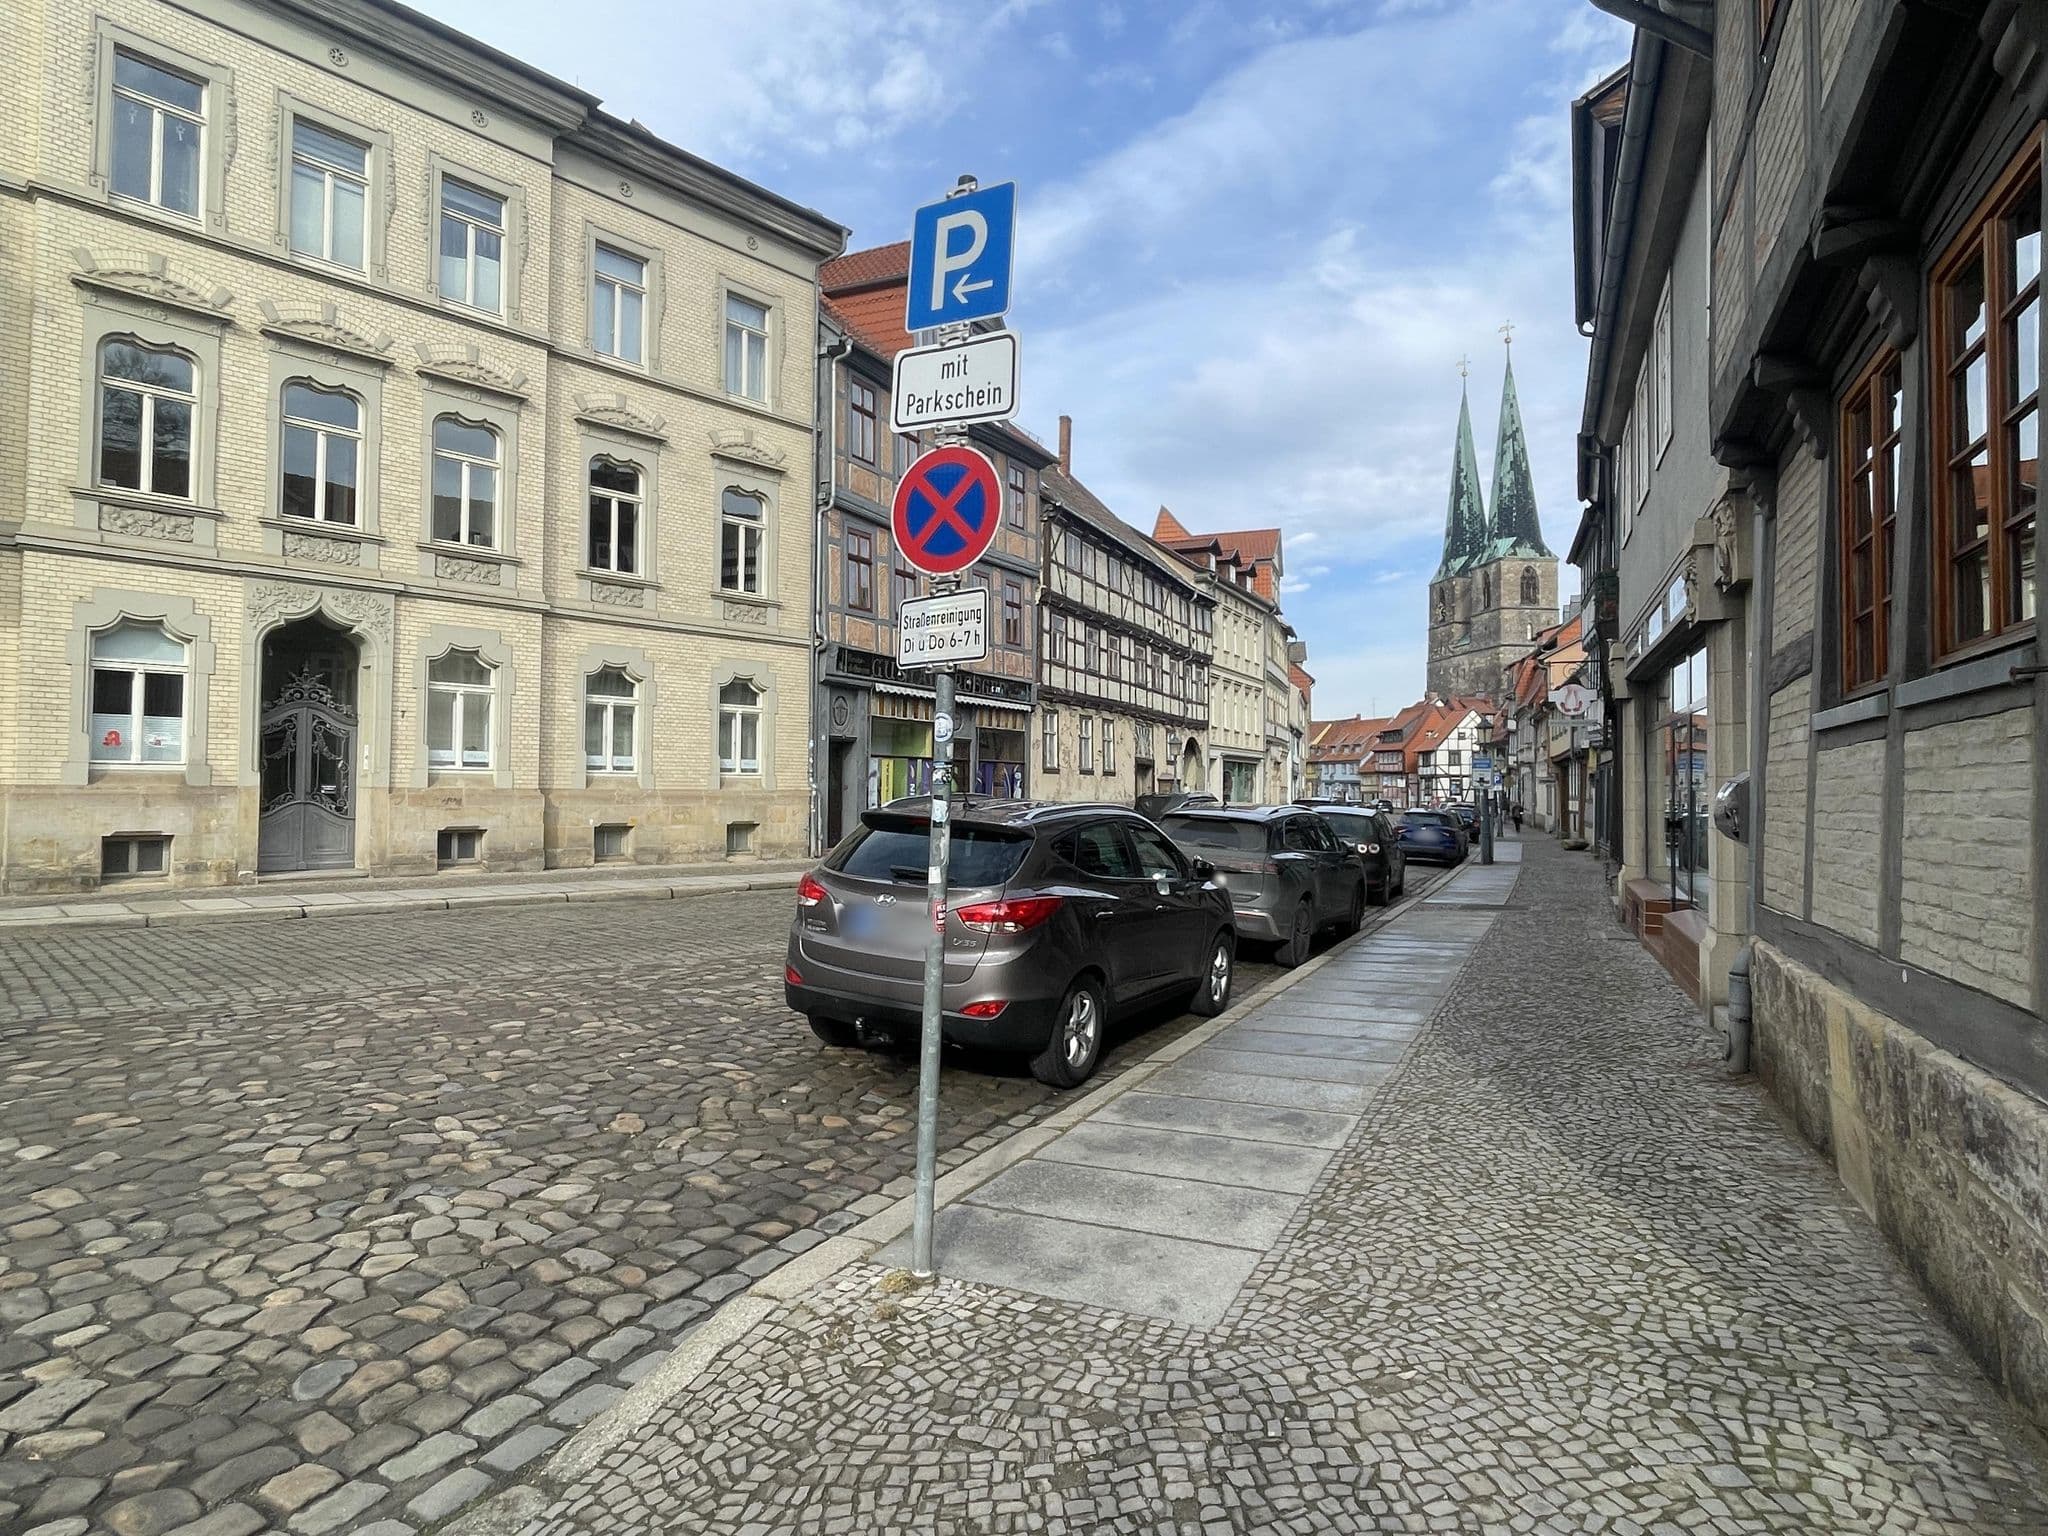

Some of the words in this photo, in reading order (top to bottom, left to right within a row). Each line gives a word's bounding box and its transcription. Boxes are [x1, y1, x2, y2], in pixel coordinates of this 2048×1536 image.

[931, 209, 988, 312] P
[941, 353, 969, 380] mit
[906, 381, 1002, 416] Parkschein
[903, 607, 982, 630] Straßenreinigung
[904, 637, 915, 654] Di
[928, 634, 945, 650] Do
[949, 631, 972, 648] 6-7
[974, 629, 980, 646] h
